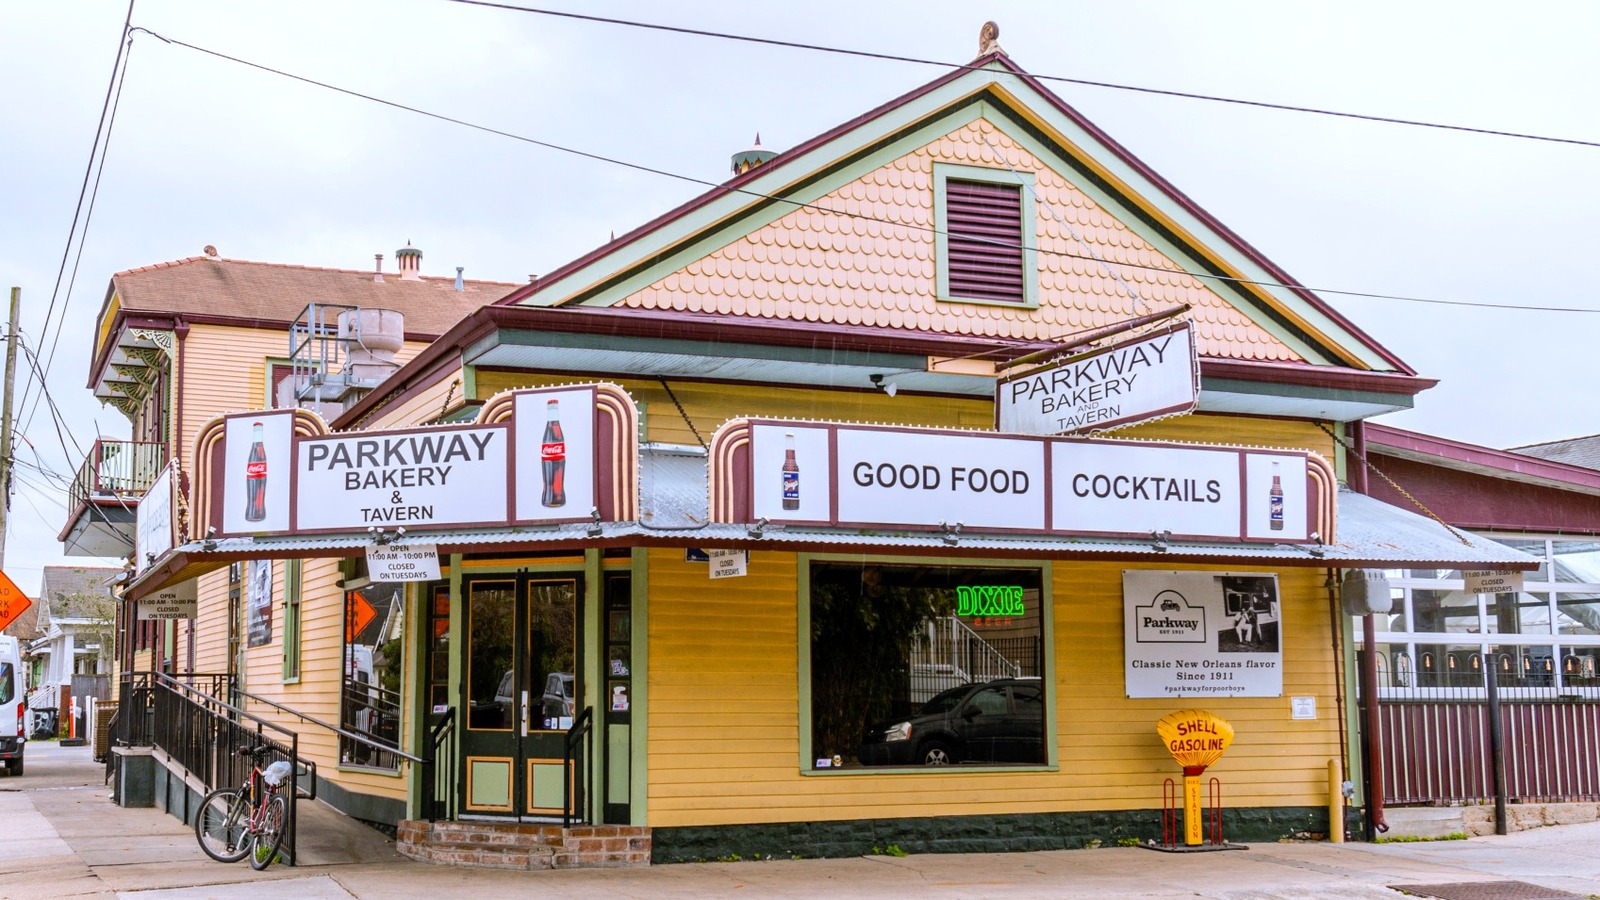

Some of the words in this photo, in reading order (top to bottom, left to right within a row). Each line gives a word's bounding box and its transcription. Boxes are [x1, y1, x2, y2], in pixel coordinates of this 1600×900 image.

[1012, 337, 1172, 404] PARKWAY
[1042, 374, 1138, 414] BAKERY
[1077, 401, 1099, 412] AND
[1057, 404, 1121, 430] TAVERN
[308, 432, 494, 472] PARKWAY
[345, 466, 452, 490] BAKERY
[853, 461, 940, 490] GOOD
[951, 467, 1030, 495] FOOD
[1072, 473, 1221, 503] COCKTAILS
[391, 490, 403, 504] &
[361, 505, 434, 522] TAVERN
[403, 552, 423, 560] 10:00
[391, 571, 428, 579] TUESDAYS
[1481, 578, 1504, 586] CLOSED
[956, 585, 1025, 616] DIXIE
[974, 617, 1012, 627] BEER
[1143, 616, 1198, 631] Parkway
[1132, 660, 1171, 668] Classic
[1175, 660, 1198, 668] New
[1202, 660, 1242, 668] Orleans
[1246, 660, 1276, 668] flavor
[1176, 672, 1206, 680] Since
[1210, 672, 1234, 680] 1911
[1164, 685, 1246, 693] #parkwayforpoorboys
[1177, 719, 1218, 736] SHELL
[1170, 738, 1224, 752] GASOLINE
